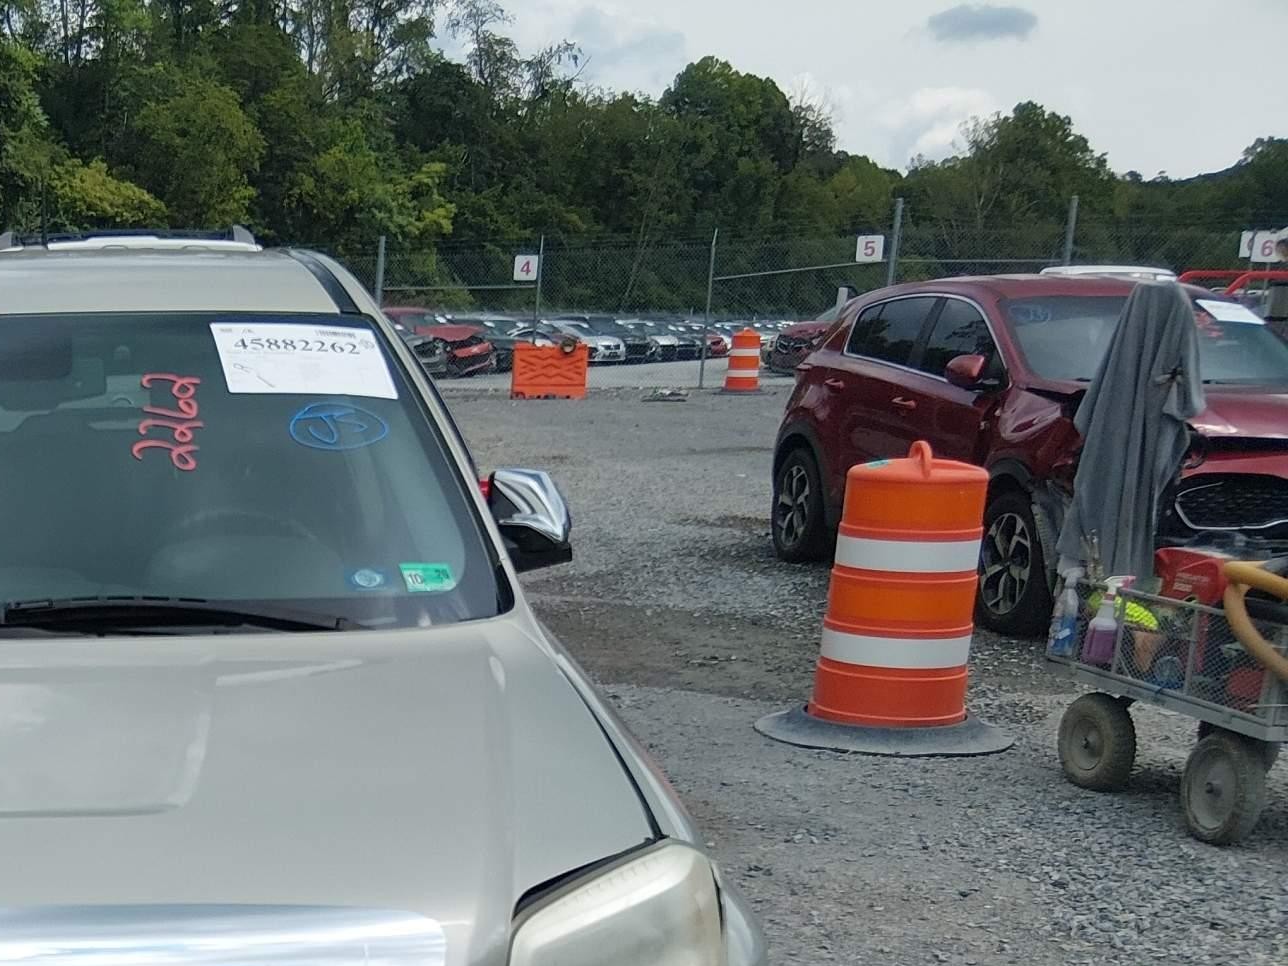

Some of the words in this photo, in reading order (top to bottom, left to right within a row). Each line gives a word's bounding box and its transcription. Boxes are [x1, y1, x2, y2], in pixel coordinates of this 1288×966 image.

[864, 240, 875, 257] 5
[1261, 239, 1273, 257] 6
[520, 260, 532, 276] 4
[233, 337, 361, 356] 45882262
